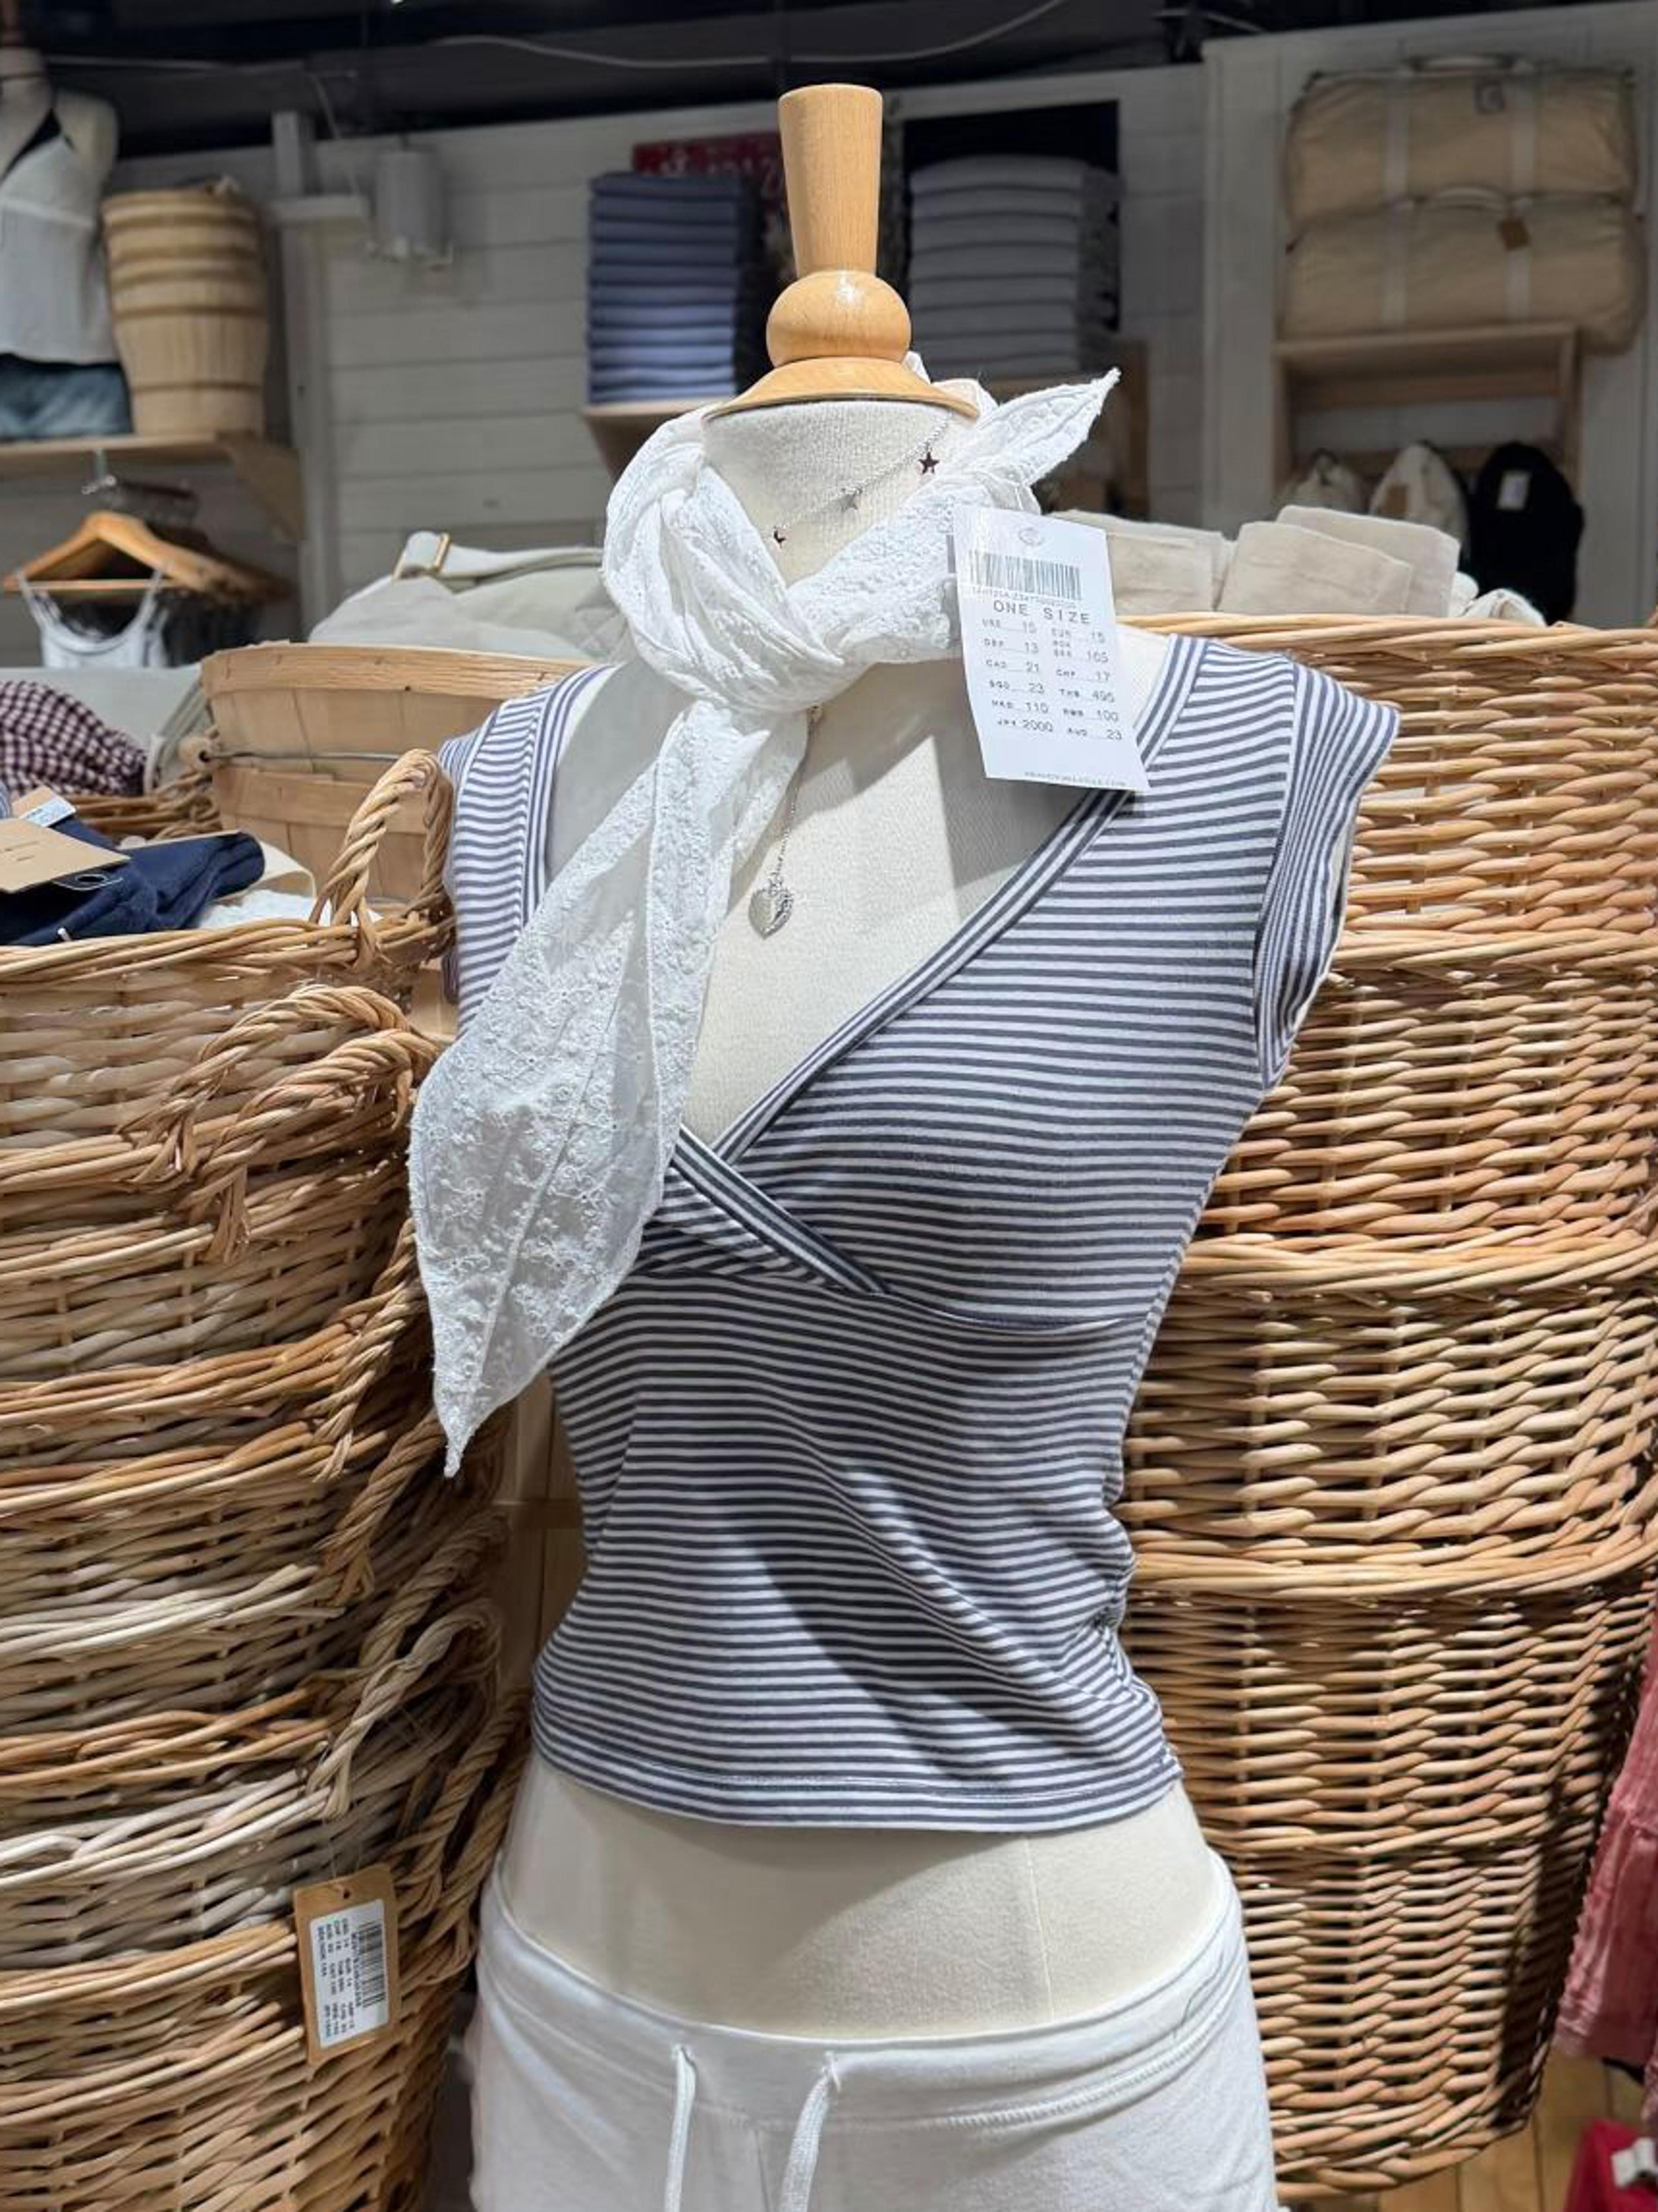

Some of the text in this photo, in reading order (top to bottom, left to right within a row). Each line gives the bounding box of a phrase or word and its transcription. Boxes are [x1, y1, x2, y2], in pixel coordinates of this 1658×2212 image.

[994, 600, 1090, 624] ONE SIZE
[1028, 681, 1045, 694] 23
[1025, 702, 1049, 714] 110
[1022, 719, 1054, 733] 2000
[1106, 729, 1123, 741] 23
